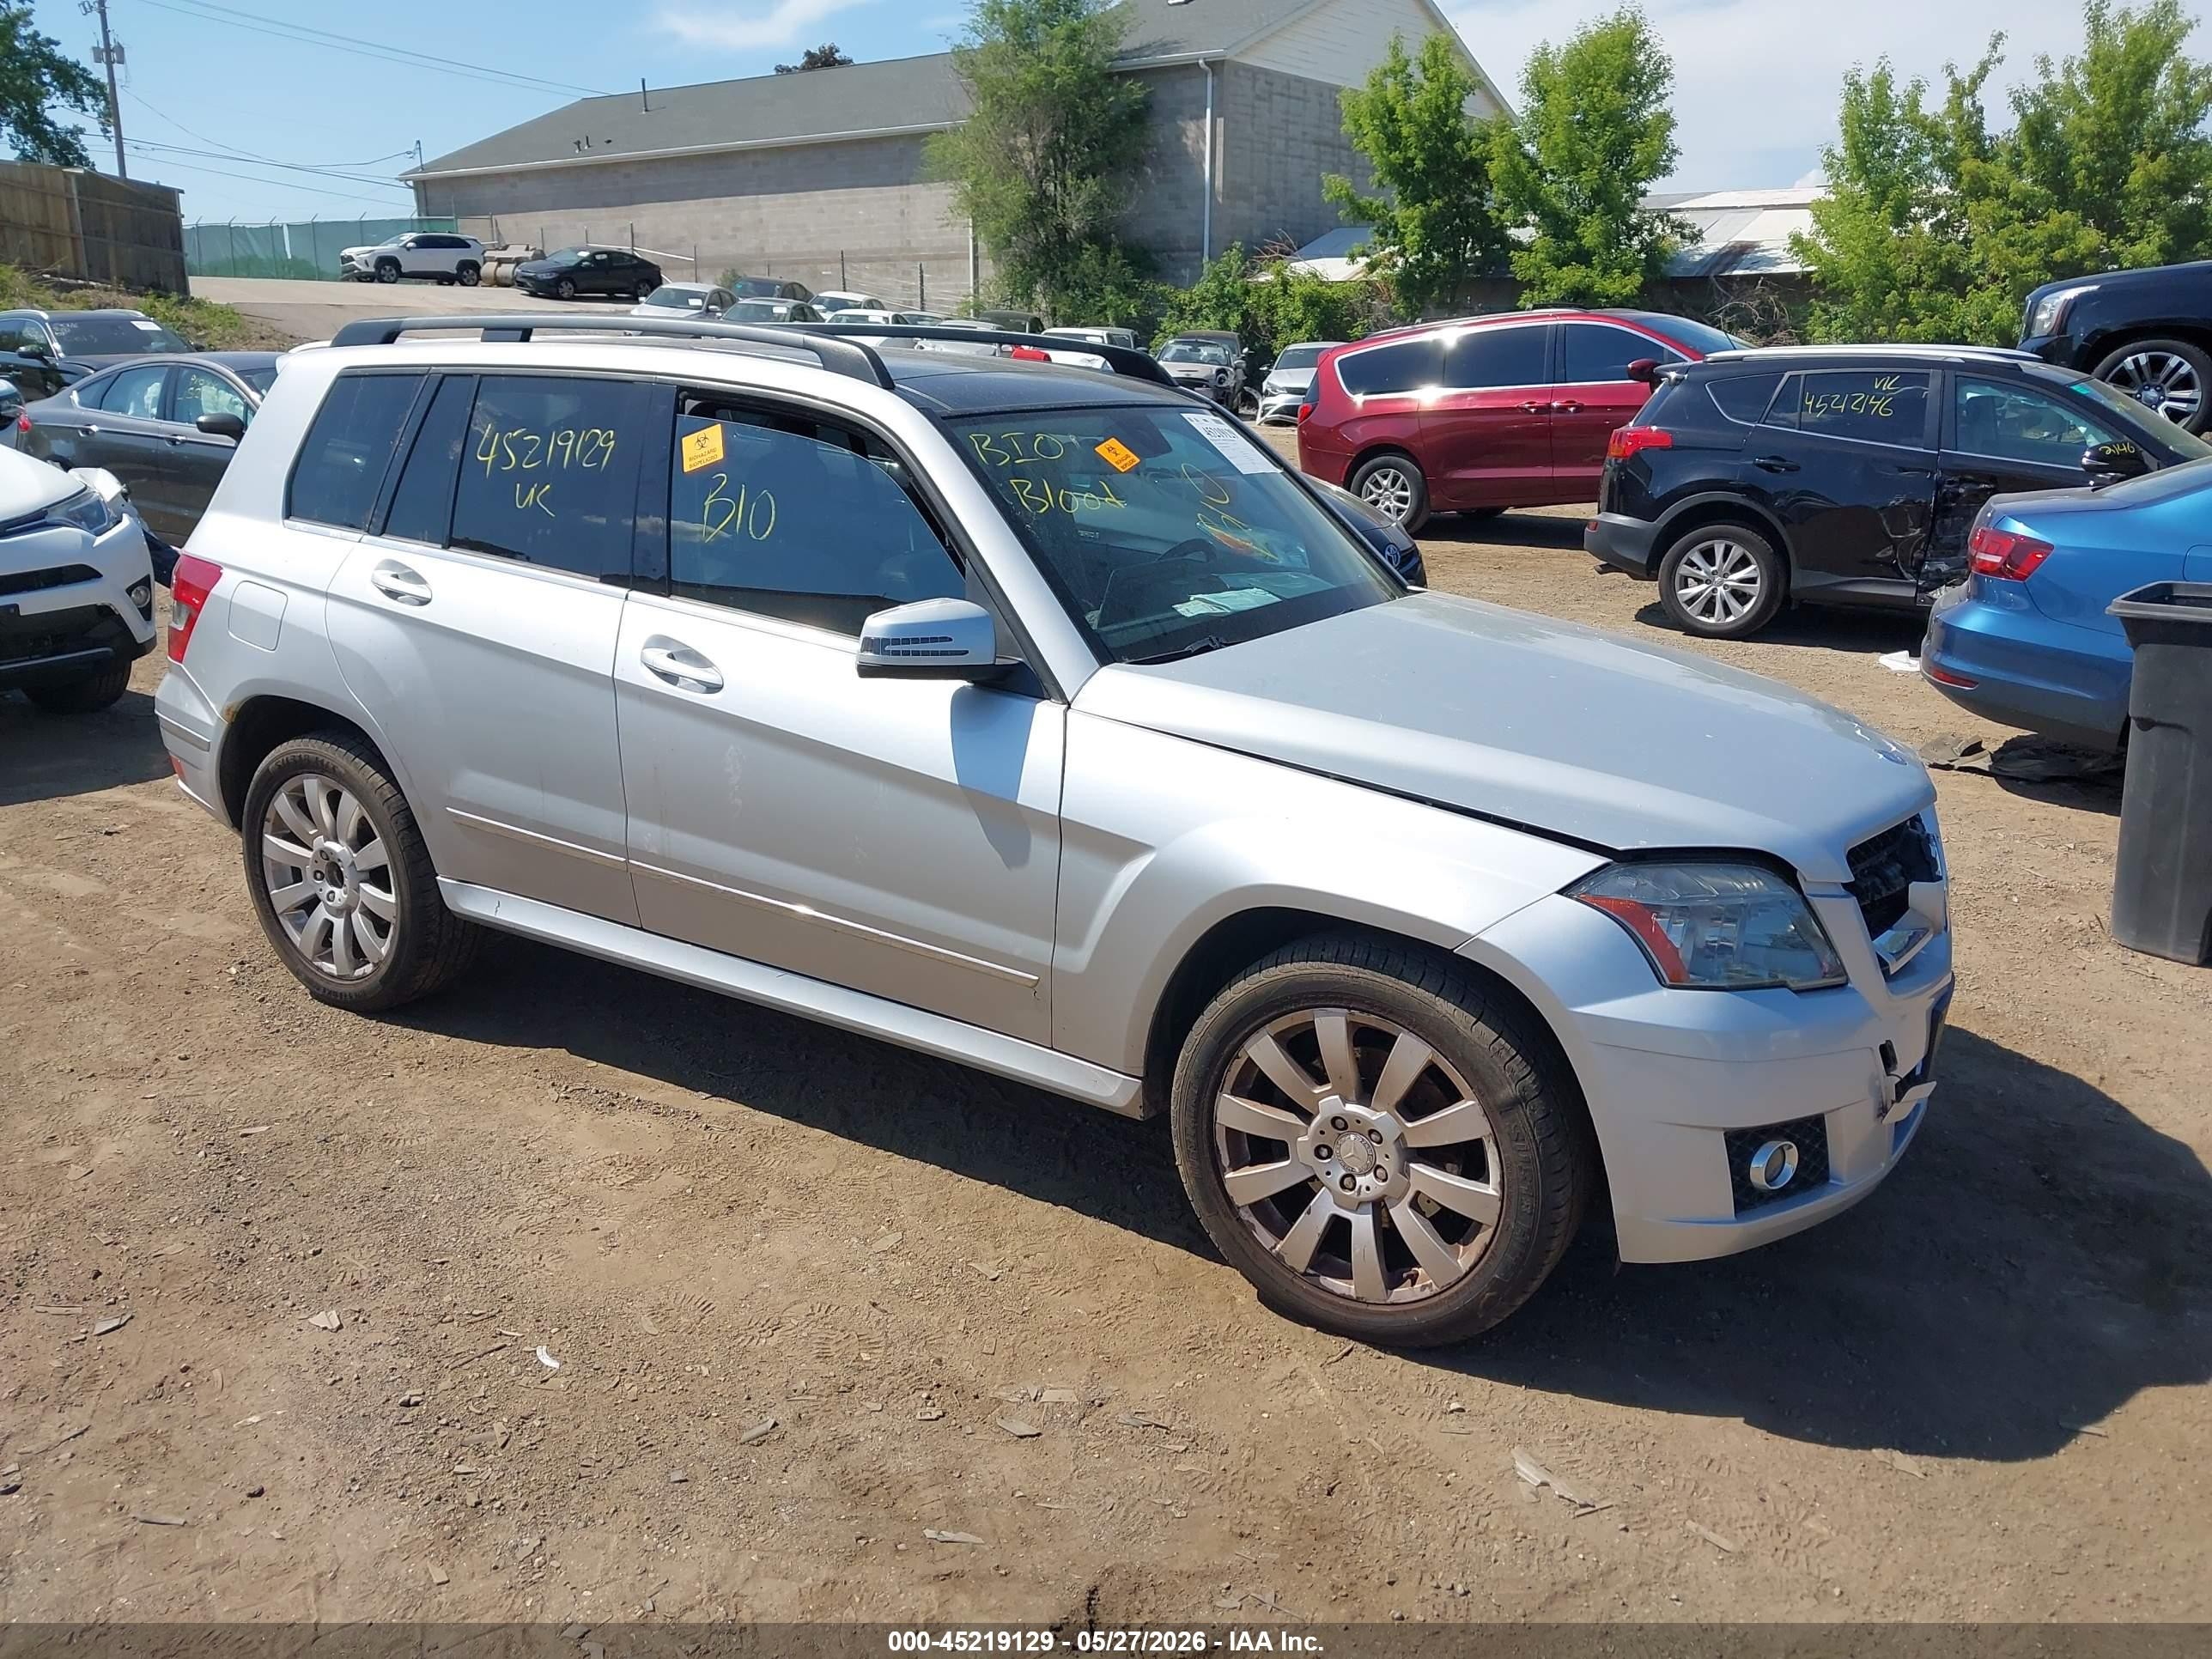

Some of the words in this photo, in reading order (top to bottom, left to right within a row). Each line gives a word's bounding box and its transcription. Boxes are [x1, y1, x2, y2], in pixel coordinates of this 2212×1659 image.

[1804, 392, 1894, 418] 45212146
[476, 423, 616, 478] 45219129
[969, 432, 1065, 466] BIO
[702, 472, 776, 544] BIO
[1009, 477, 1127, 514] Blood
